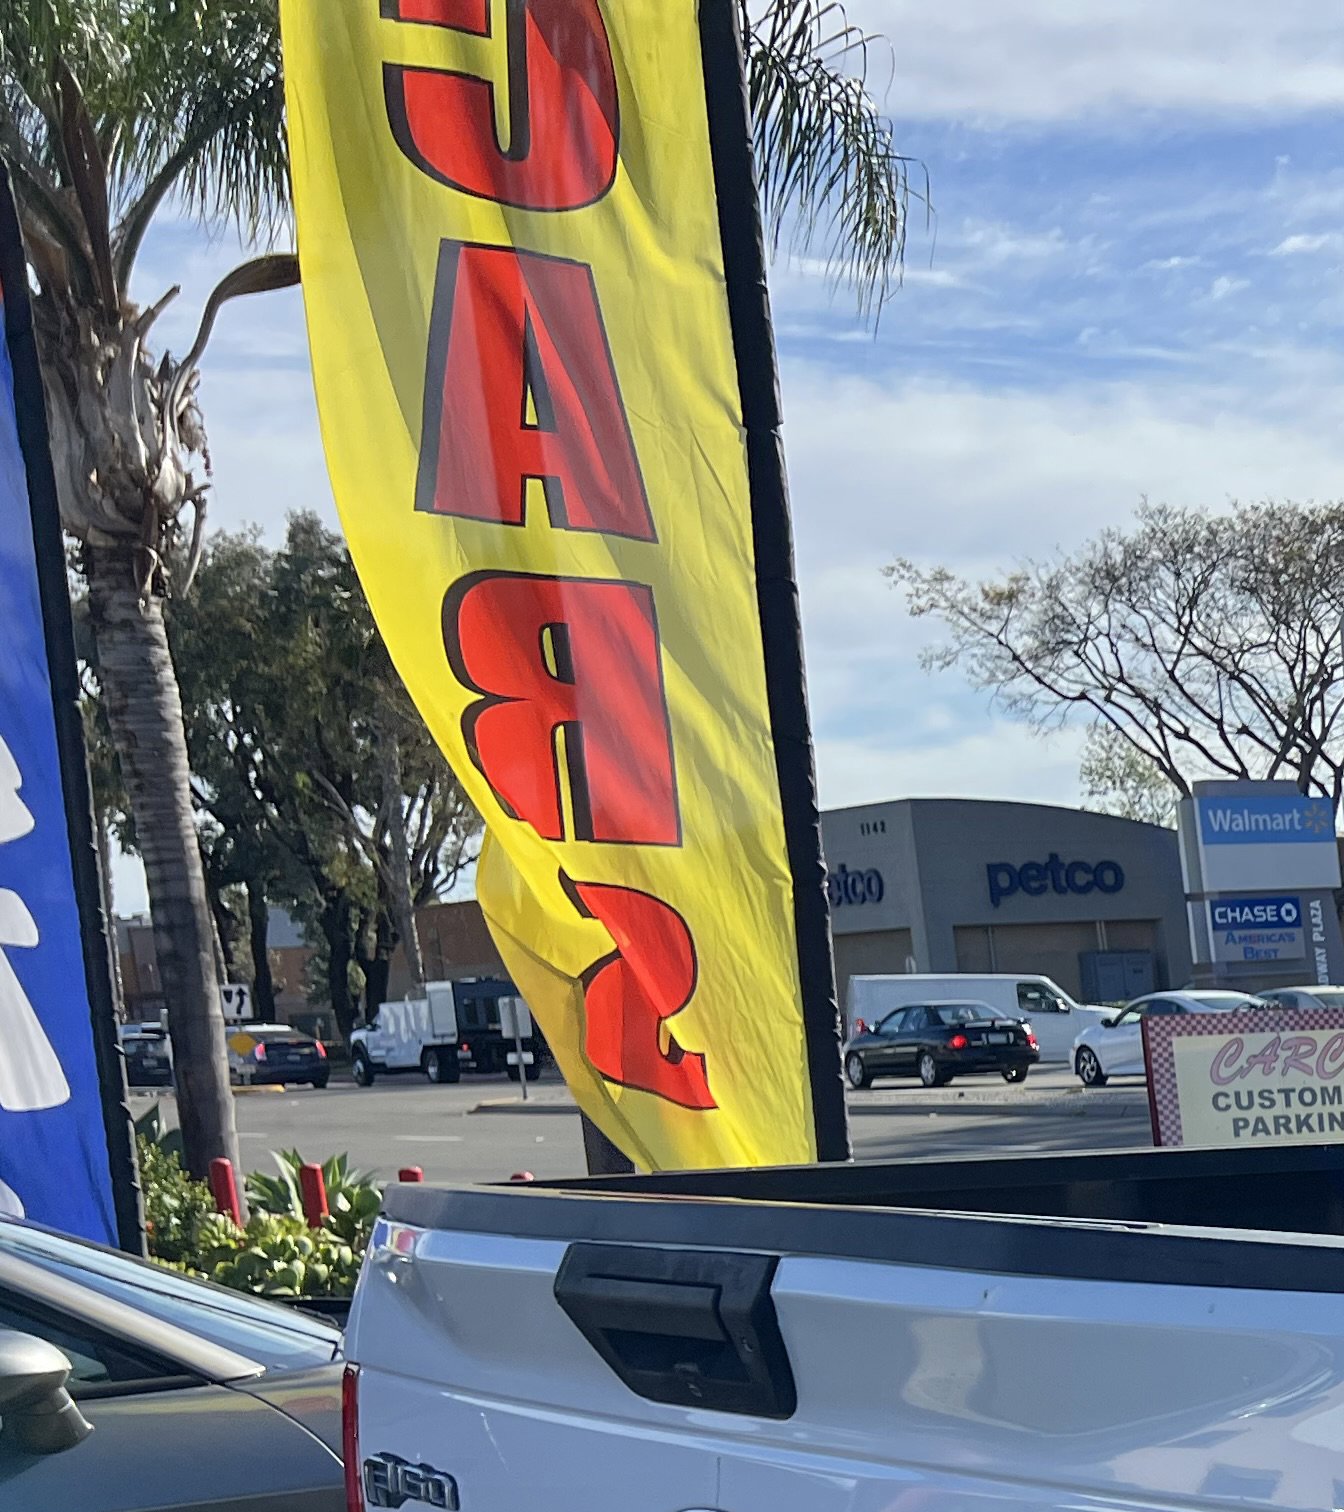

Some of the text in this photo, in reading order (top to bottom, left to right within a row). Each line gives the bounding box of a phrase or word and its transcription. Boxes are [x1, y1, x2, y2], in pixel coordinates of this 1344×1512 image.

[860, 821, 886, 835] 1142
[1208, 809, 1302, 832] Walmart
[829, 864, 884, 907] etco
[987, 853, 1125, 908] petco
[1214, 905, 1278, 924] CHASE
[1310, 900, 1325, 942] PLAZA
